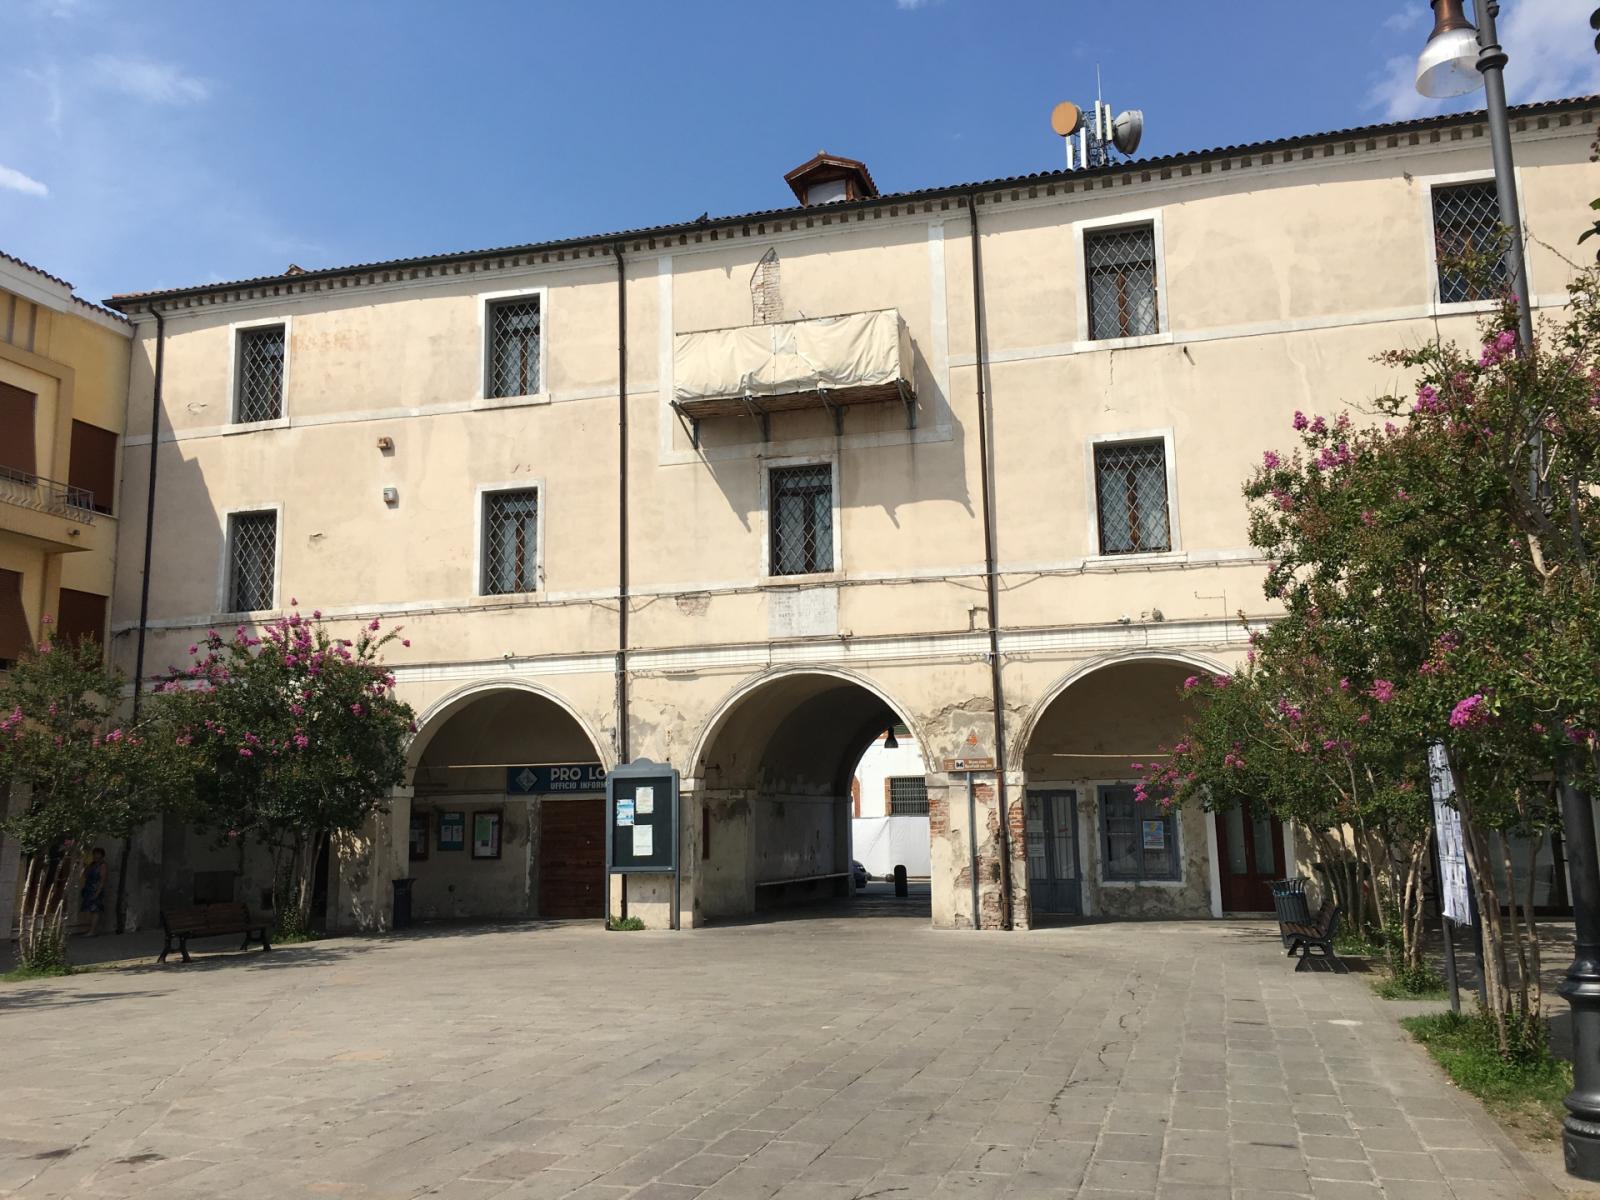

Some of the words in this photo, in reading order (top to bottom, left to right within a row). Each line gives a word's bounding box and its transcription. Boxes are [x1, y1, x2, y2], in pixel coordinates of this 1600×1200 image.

[551, 767, 582, 780] PRO
[588, 767, 606, 780] LO
[551, 781, 577, 790] UFFICIO
